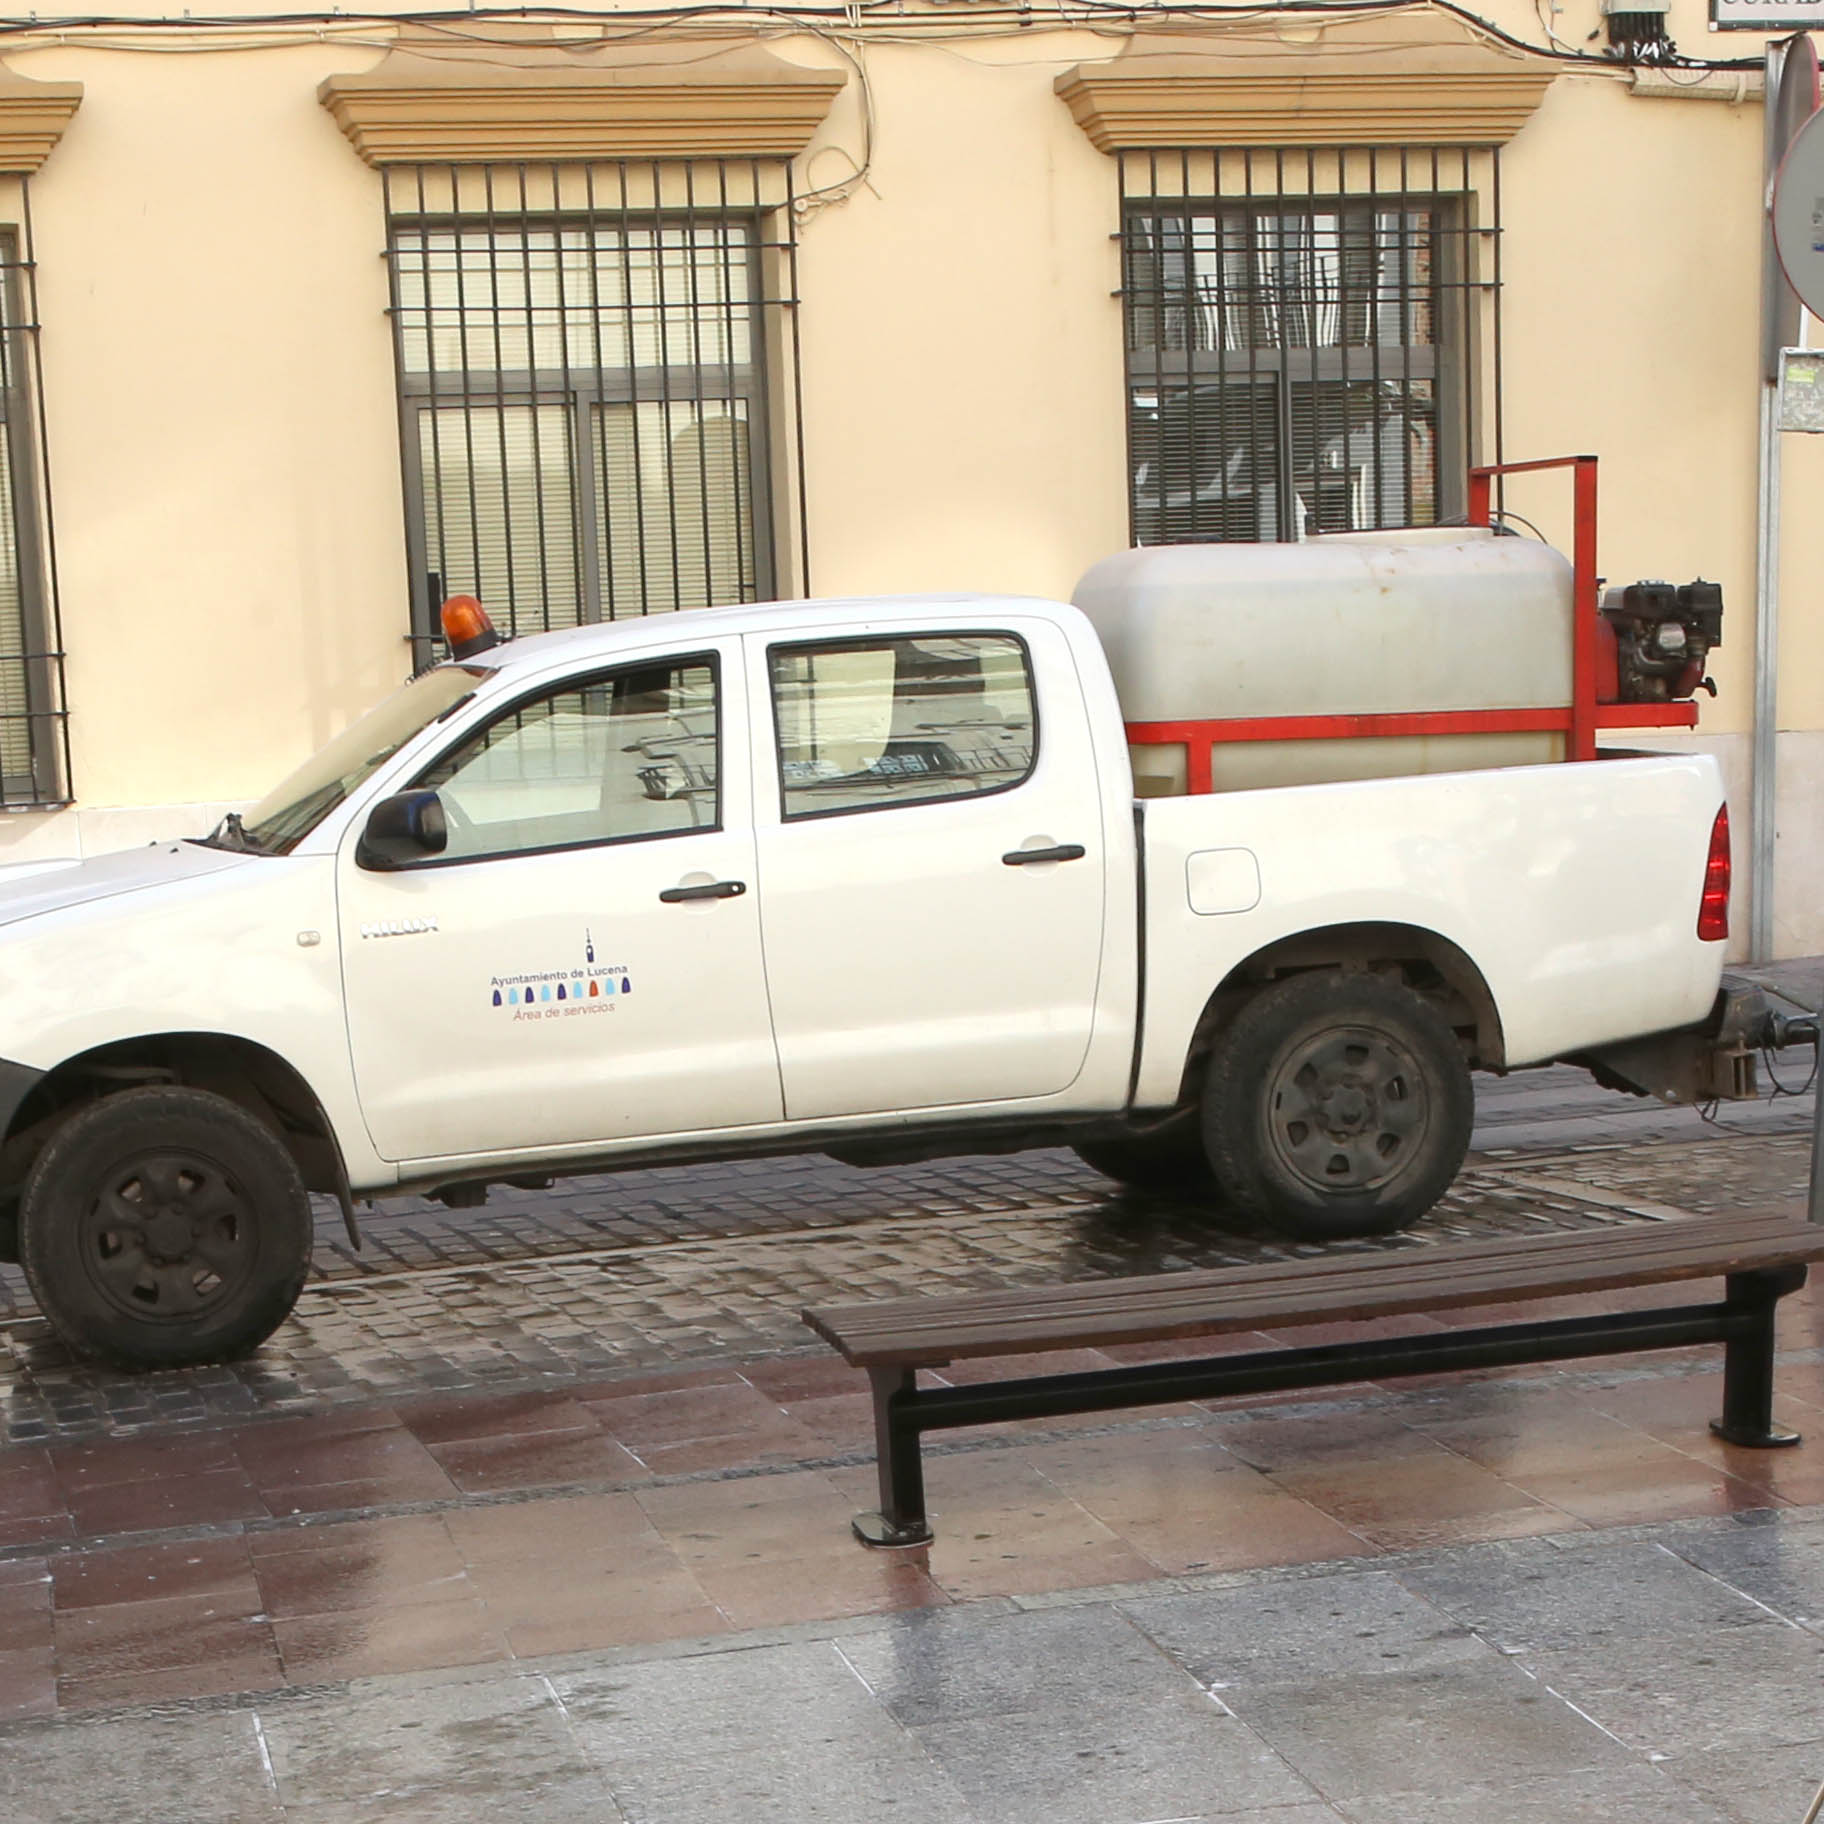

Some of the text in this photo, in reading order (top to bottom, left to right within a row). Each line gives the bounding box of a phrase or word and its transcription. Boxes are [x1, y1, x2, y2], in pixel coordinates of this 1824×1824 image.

[490, 964, 629, 988] Ayuntamiento de Lucena
[545, 1006, 561, 1019] de
[563, 1001, 616, 1018] servicios
